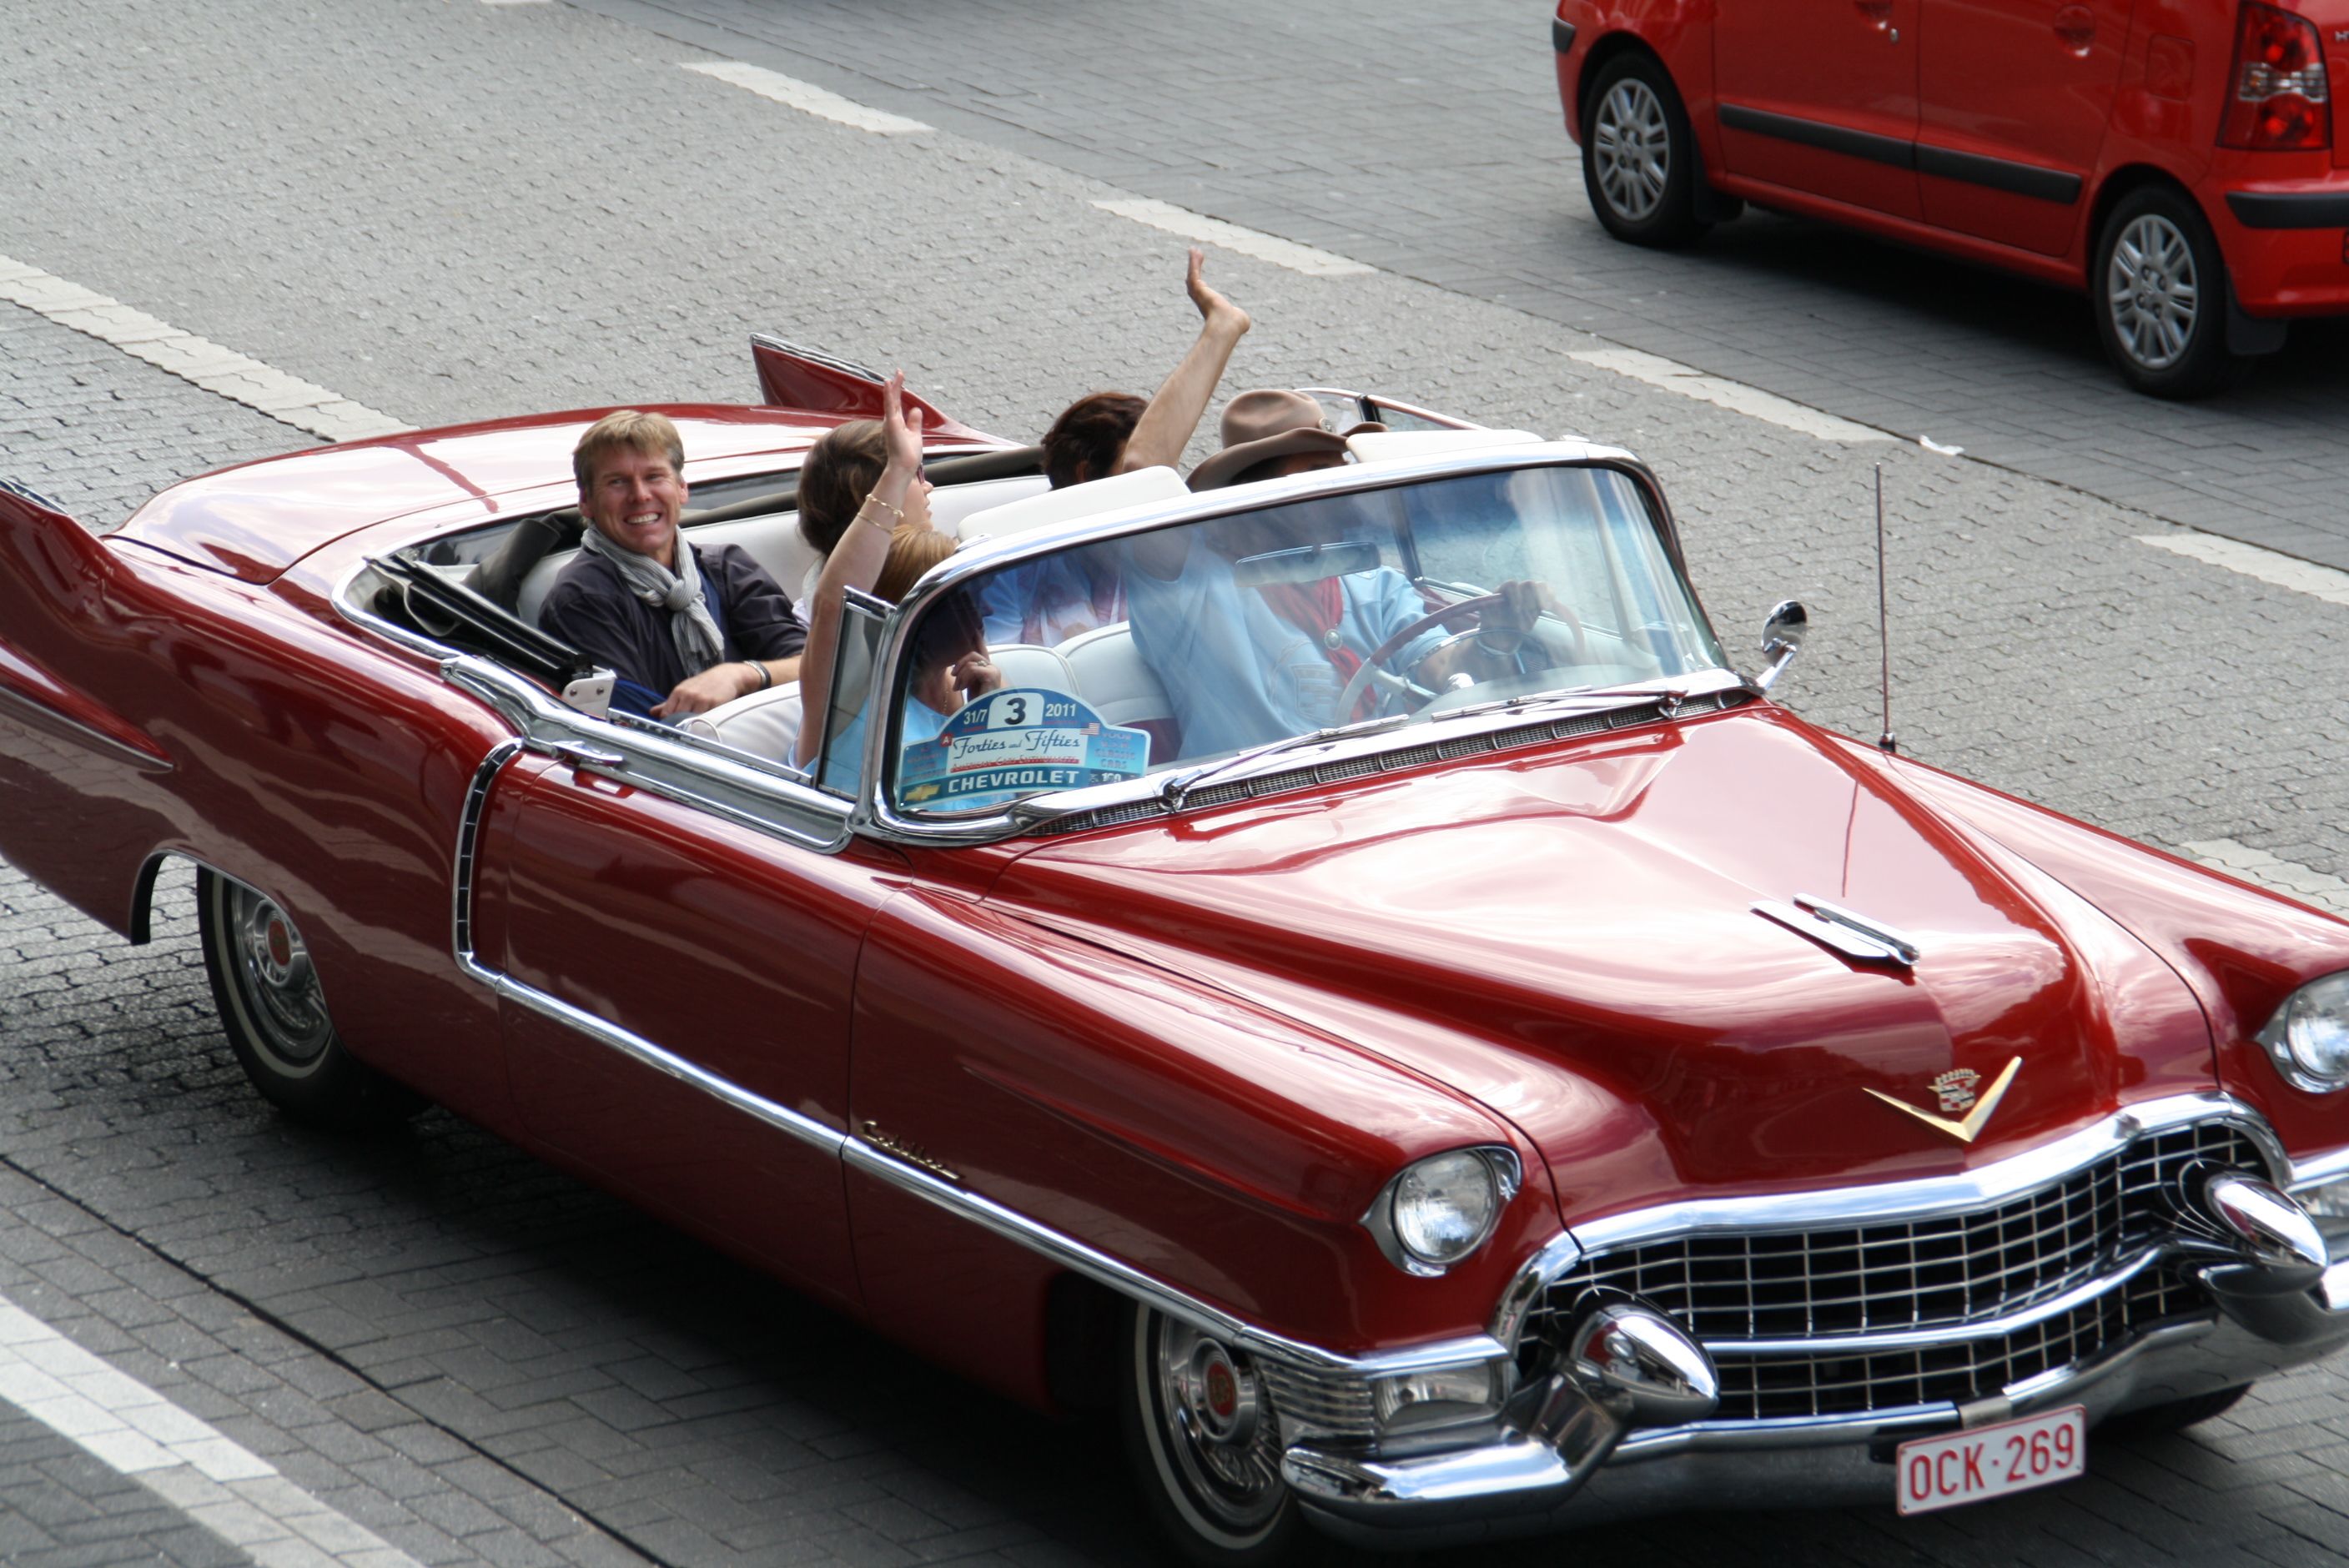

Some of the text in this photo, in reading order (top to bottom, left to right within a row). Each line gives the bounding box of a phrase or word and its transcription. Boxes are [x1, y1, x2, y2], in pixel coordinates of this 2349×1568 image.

[963, 697, 1076, 726] 31/7 3 2011
[953, 737, 1006, 759] Forties
[1025, 729, 1080, 754] Fifties
[948, 770, 1080, 794] CHEVROLET
